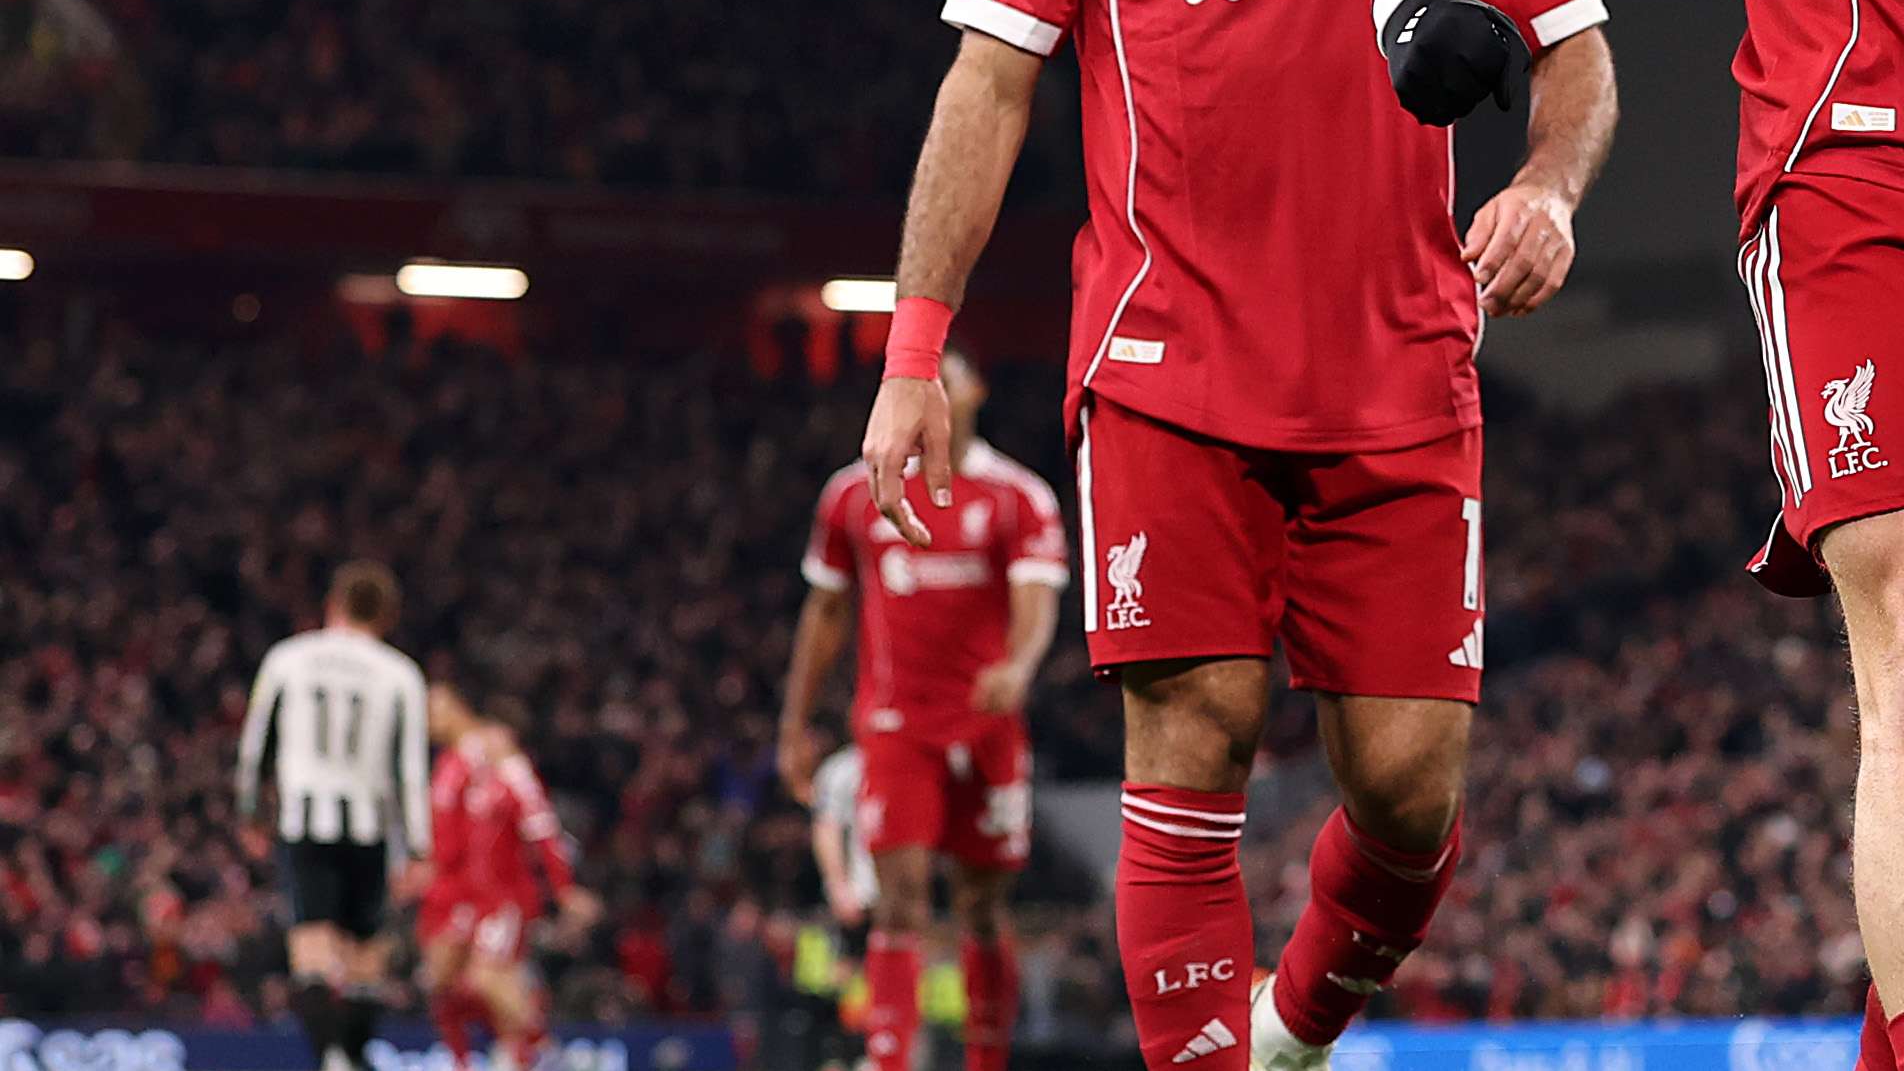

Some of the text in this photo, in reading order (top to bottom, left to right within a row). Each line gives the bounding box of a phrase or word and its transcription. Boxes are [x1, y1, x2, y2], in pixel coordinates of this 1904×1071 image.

[1829, 446, 1889, 478] L.F.C.
[312, 686, 365, 760] 11
[1154, 958, 1235, 995] LFC
